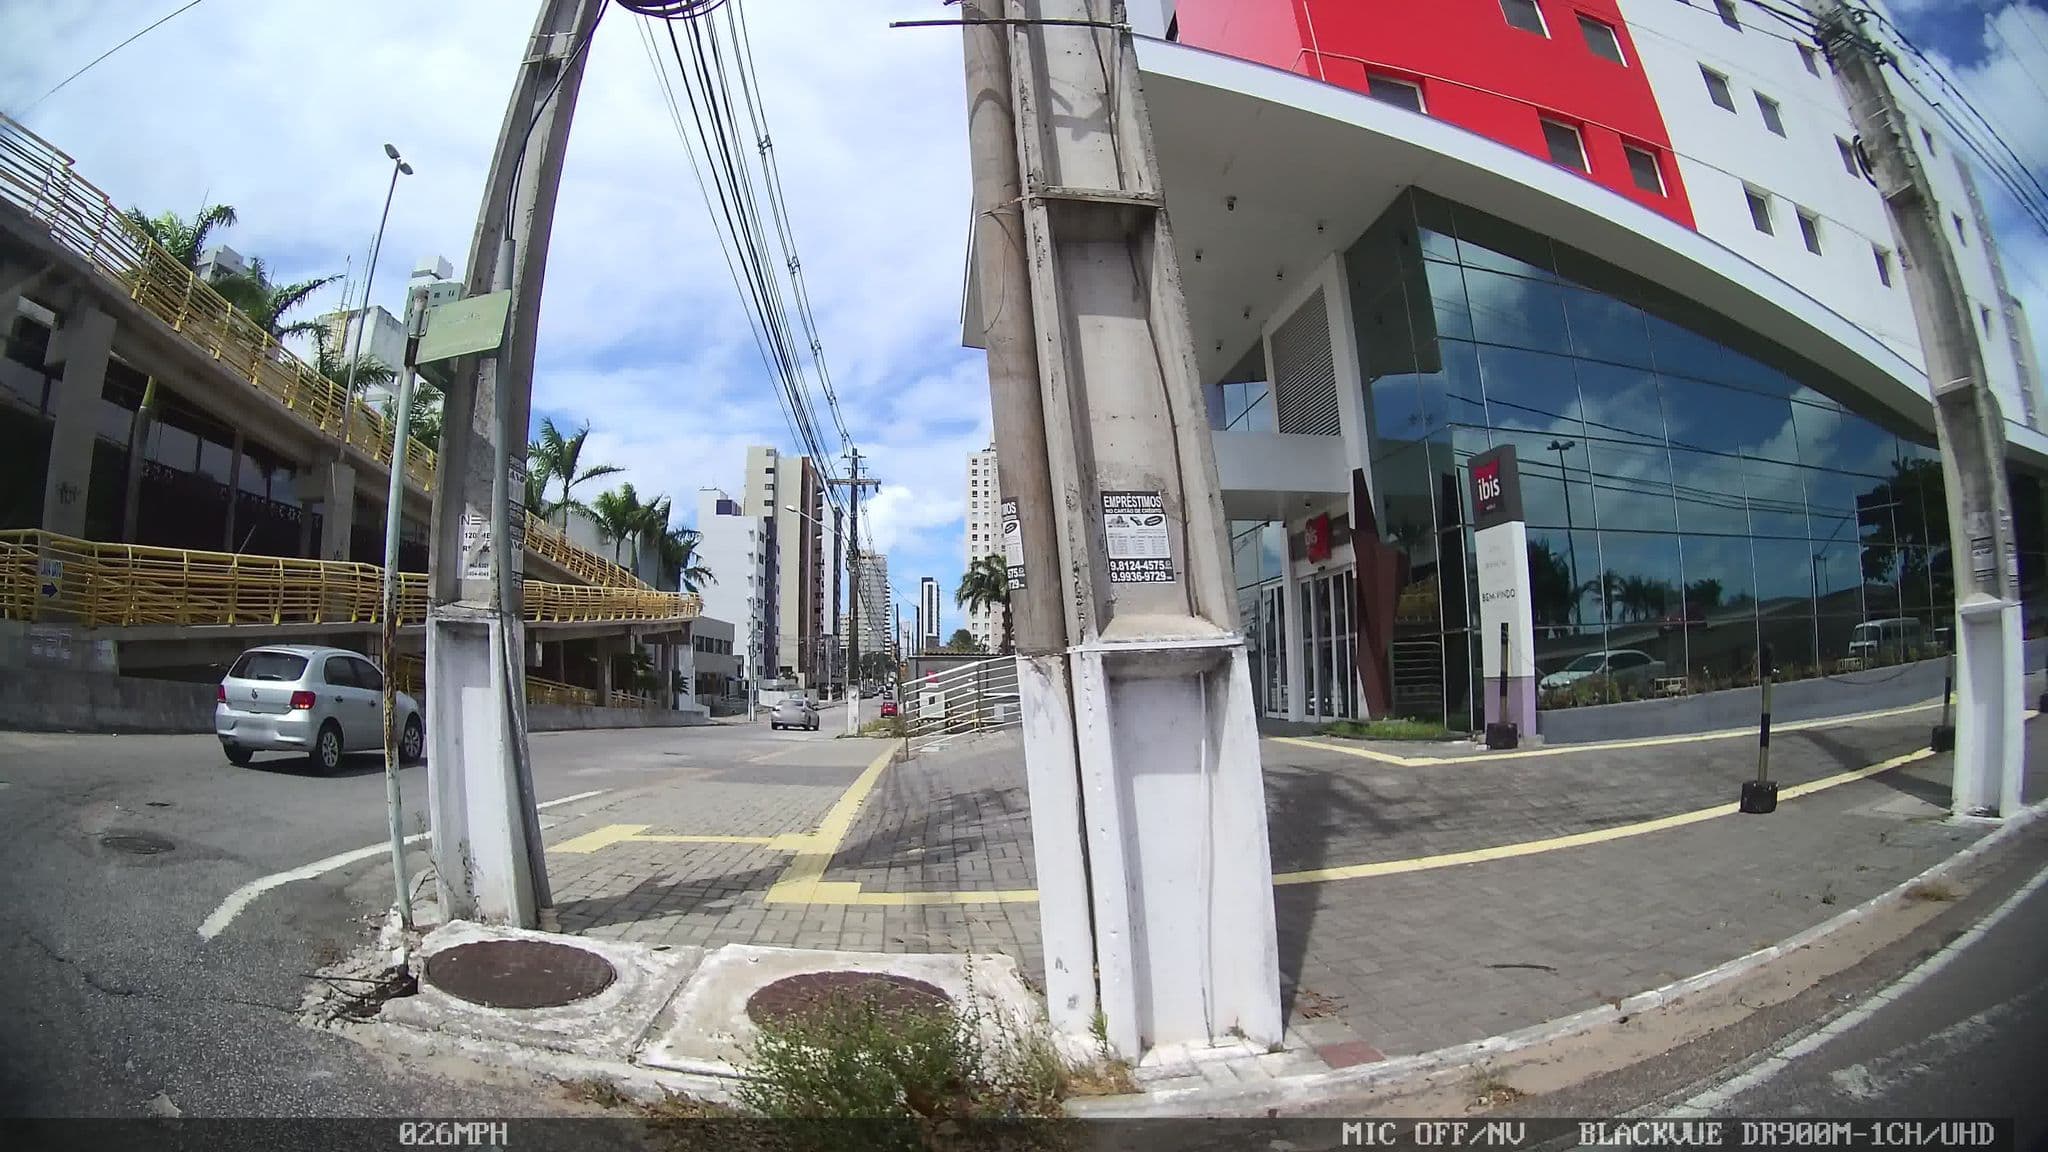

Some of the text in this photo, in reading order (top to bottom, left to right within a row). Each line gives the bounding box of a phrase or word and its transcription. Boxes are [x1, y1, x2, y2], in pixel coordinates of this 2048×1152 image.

[1478, 475, 1501, 501] ibis
[1103, 493, 1162, 508] EMPRÉSTIMOS
[1110, 559, 1165, 571] 9.8124-4575
[1111, 570, 1167, 582] 9.9936-9729
